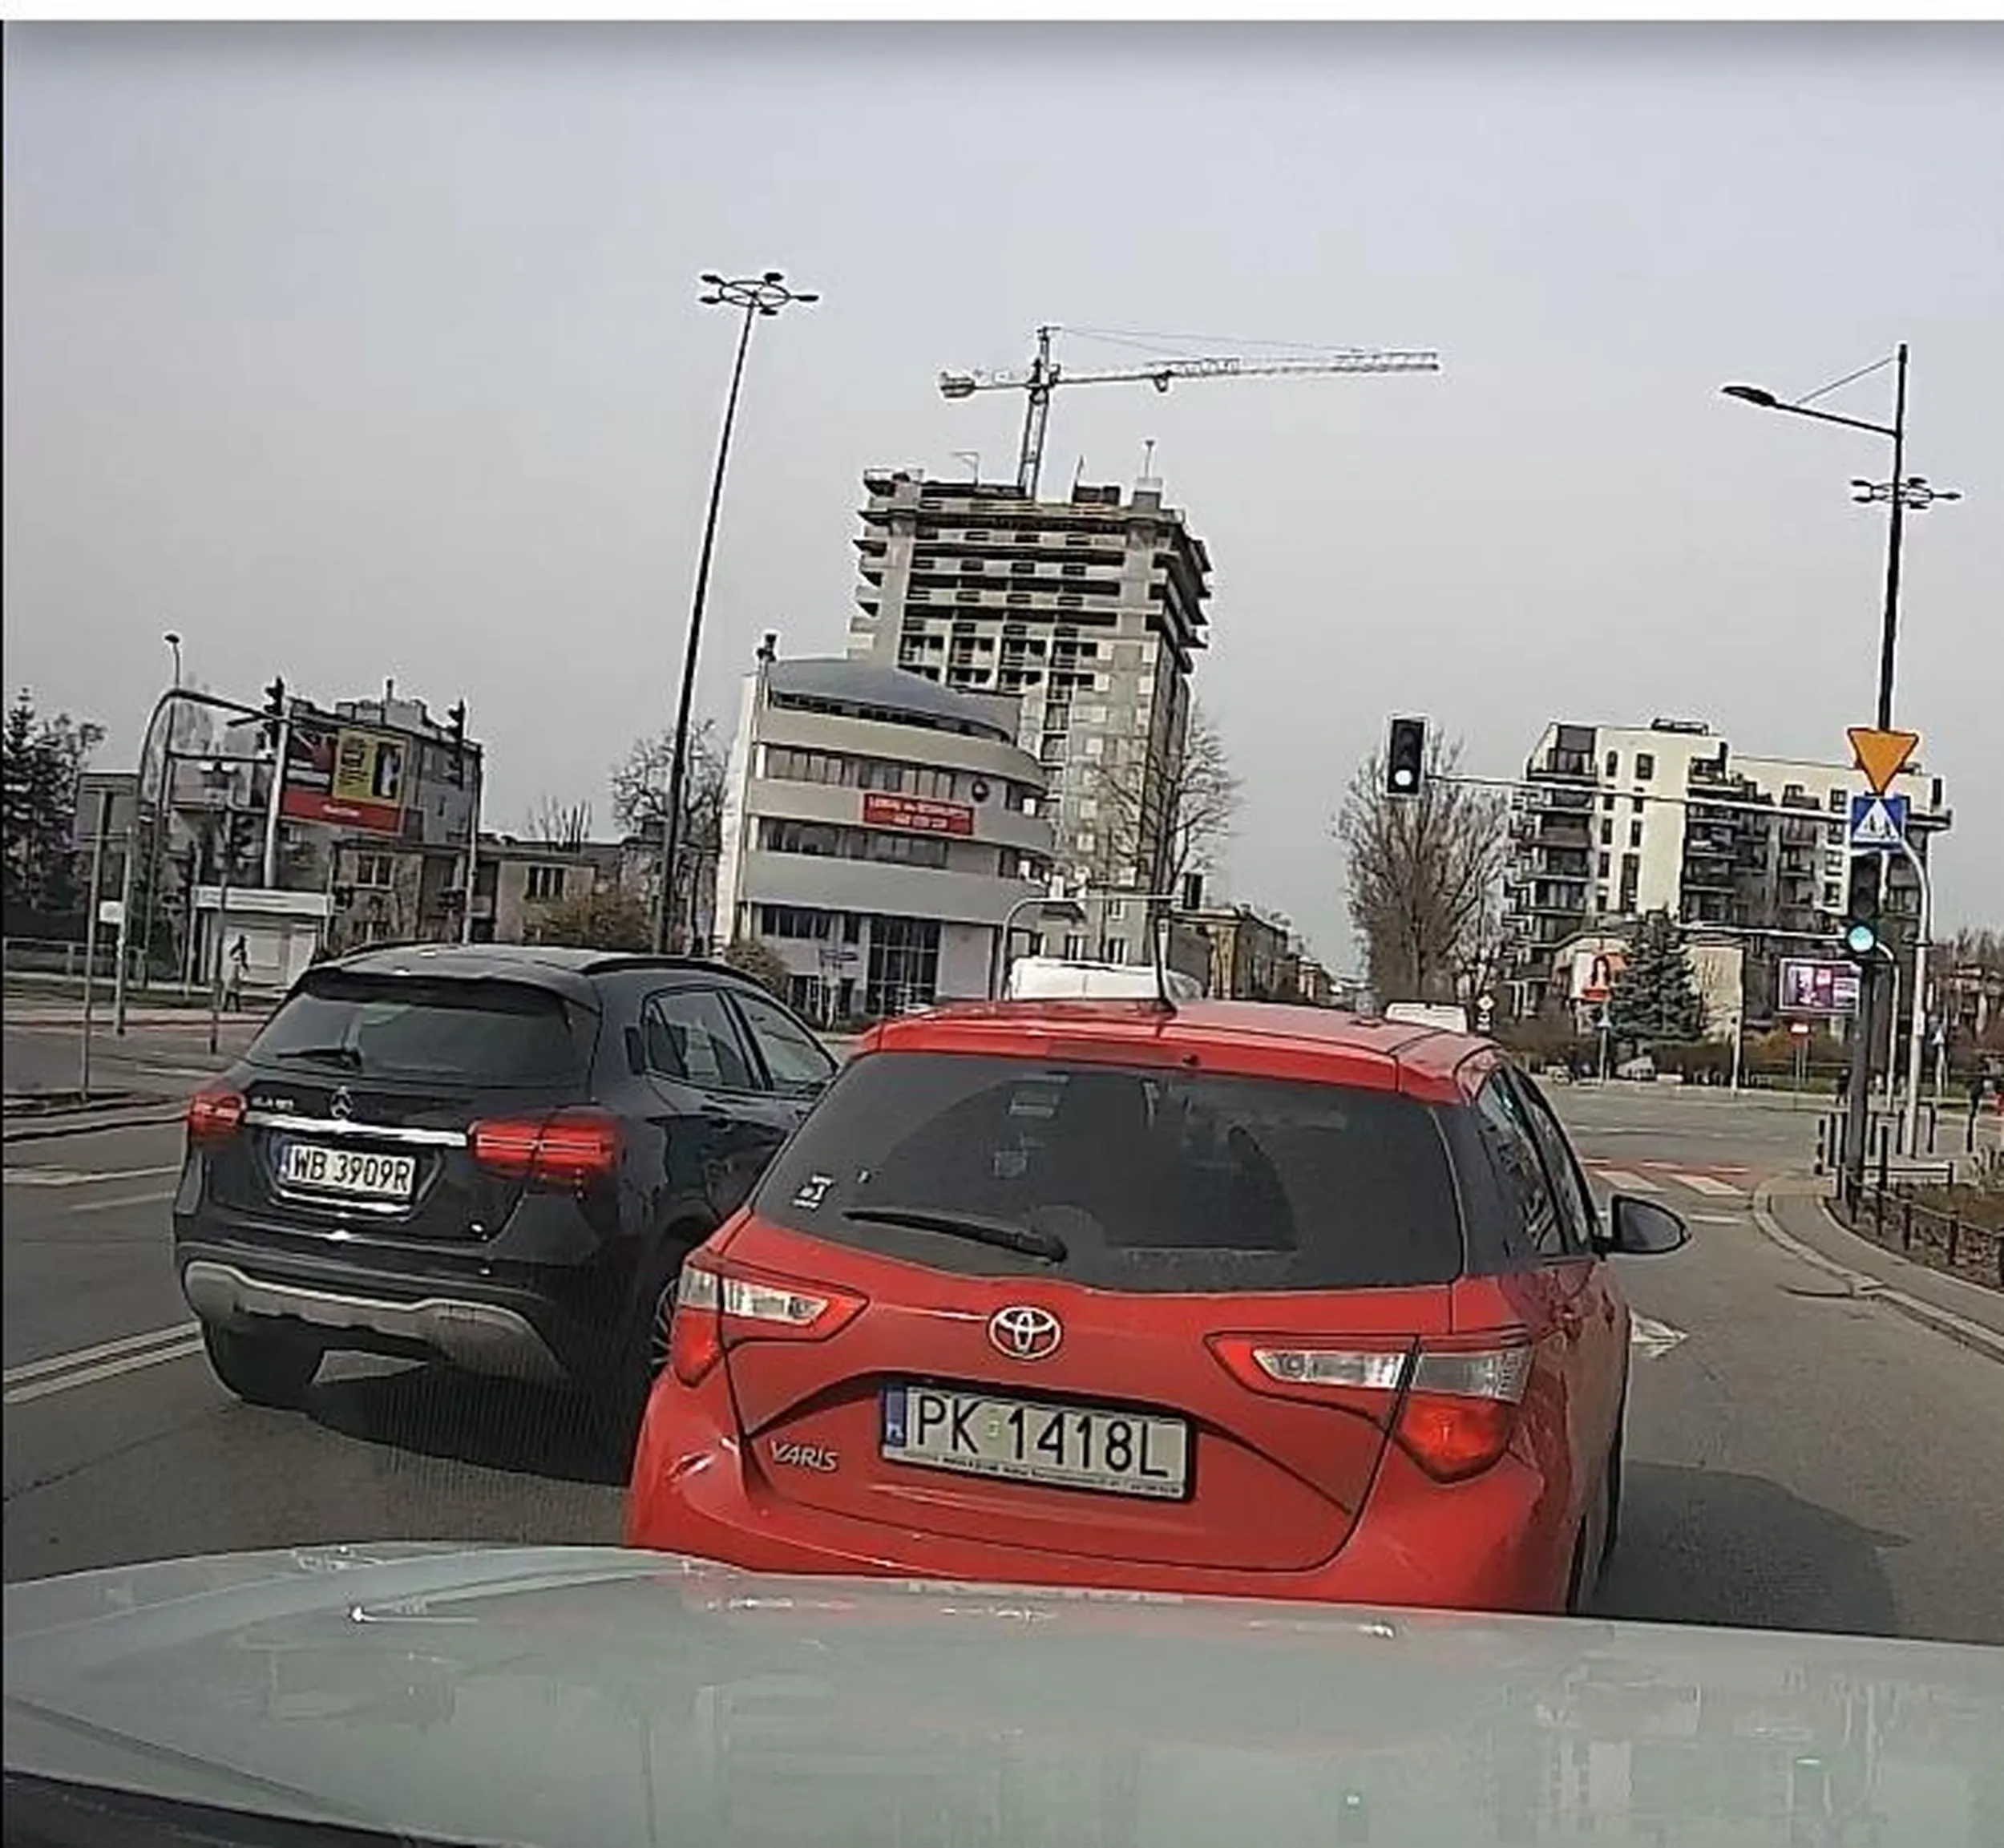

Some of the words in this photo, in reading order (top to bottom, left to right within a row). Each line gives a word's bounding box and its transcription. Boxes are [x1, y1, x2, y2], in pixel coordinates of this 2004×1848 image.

[294, 1148, 328, 1181] WB
[333, 1154, 410, 1191] 3909R
[917, 1394, 983, 1455] PK
[1008, 1406, 1169, 1478] 1418L
